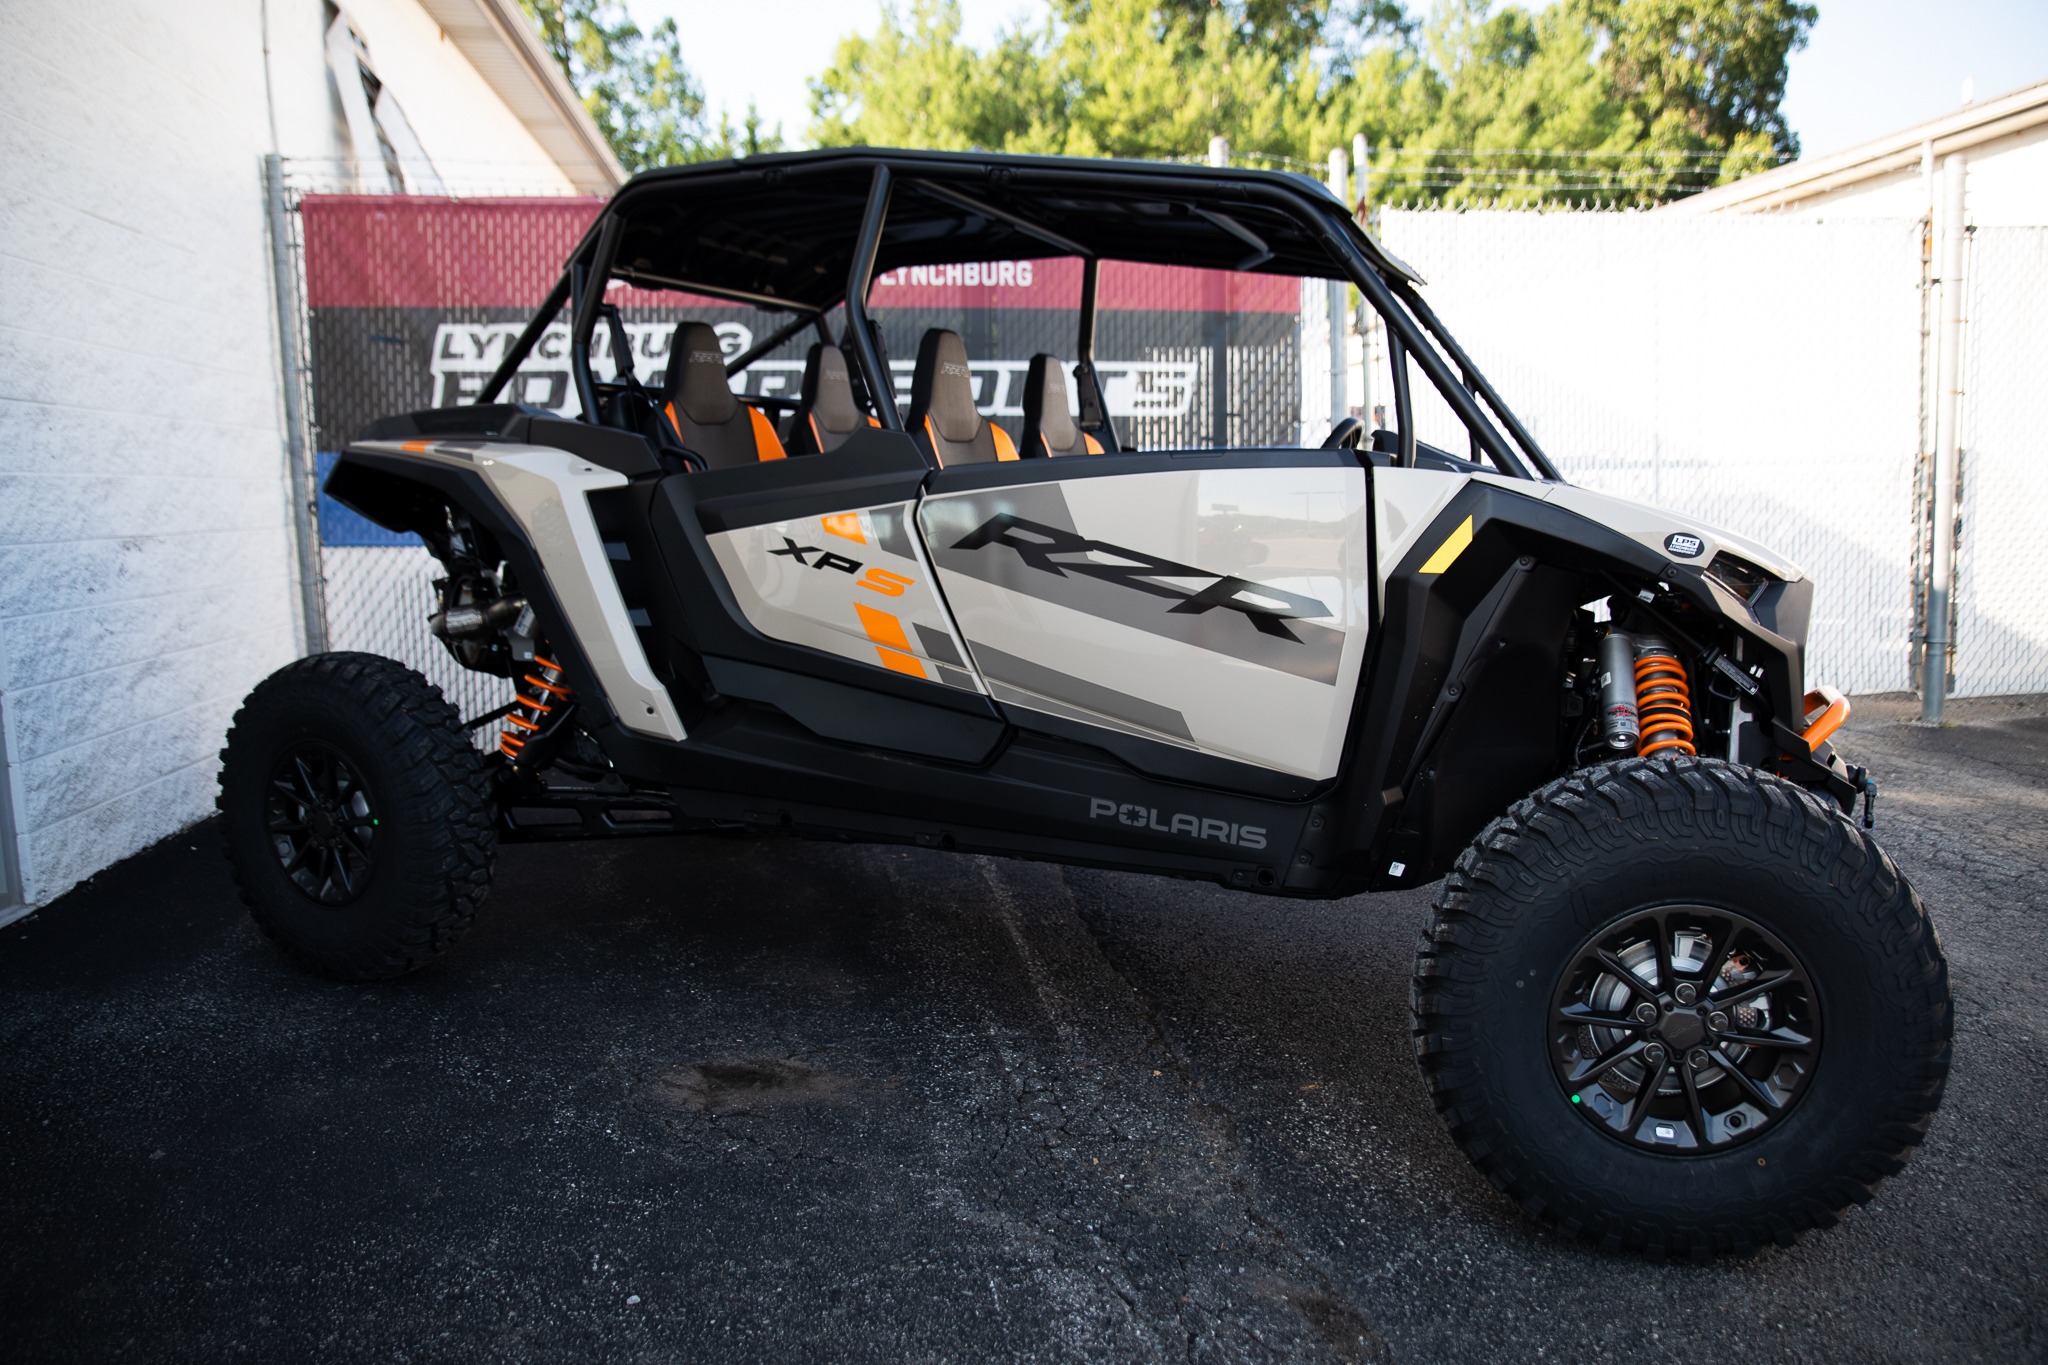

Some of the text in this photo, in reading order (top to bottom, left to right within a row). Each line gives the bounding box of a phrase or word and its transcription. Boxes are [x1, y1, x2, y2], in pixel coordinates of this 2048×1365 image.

[440, 331, 743, 360] LYCUG
[766, 536, 915, 597] XPS
[1675, 537, 1697, 547] LPS
[949, 512, 1334, 645] RZR
[1089, 797, 1267, 850] POLARIS
